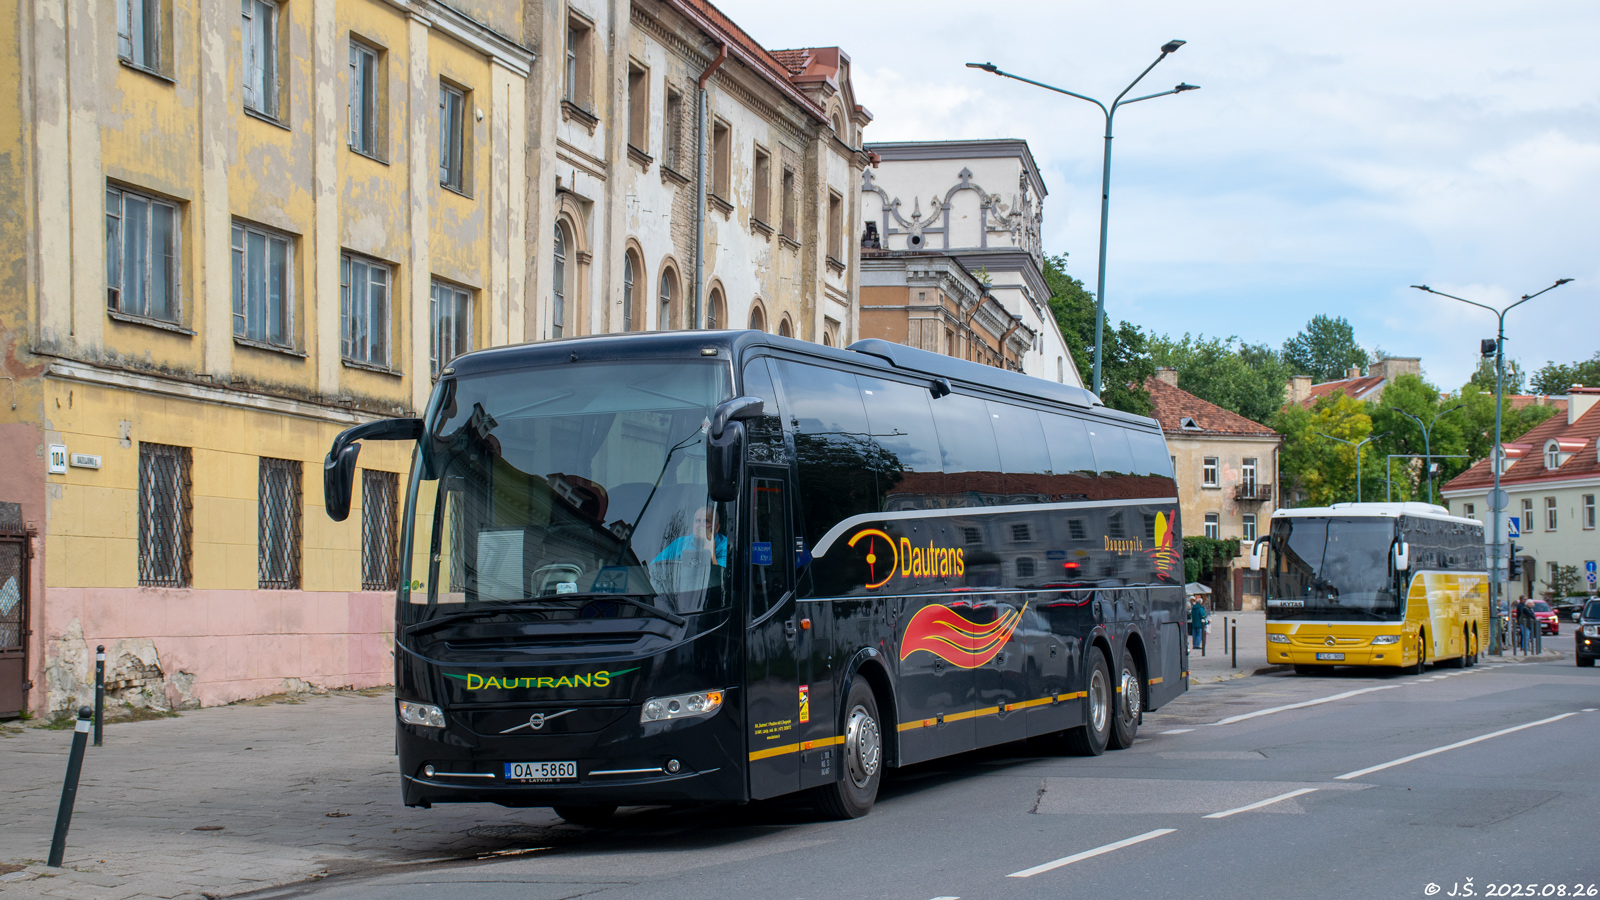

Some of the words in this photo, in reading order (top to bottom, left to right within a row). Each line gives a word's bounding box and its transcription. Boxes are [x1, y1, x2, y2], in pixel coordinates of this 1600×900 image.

[51, 452, 65, 466] 10A
[1104, 535, 1143, 556] Daugavpils
[900, 536, 965, 579] Dautrans
[466, 671, 610, 690] DAUTRANS
[514, 763, 575, 778] OA-5860
